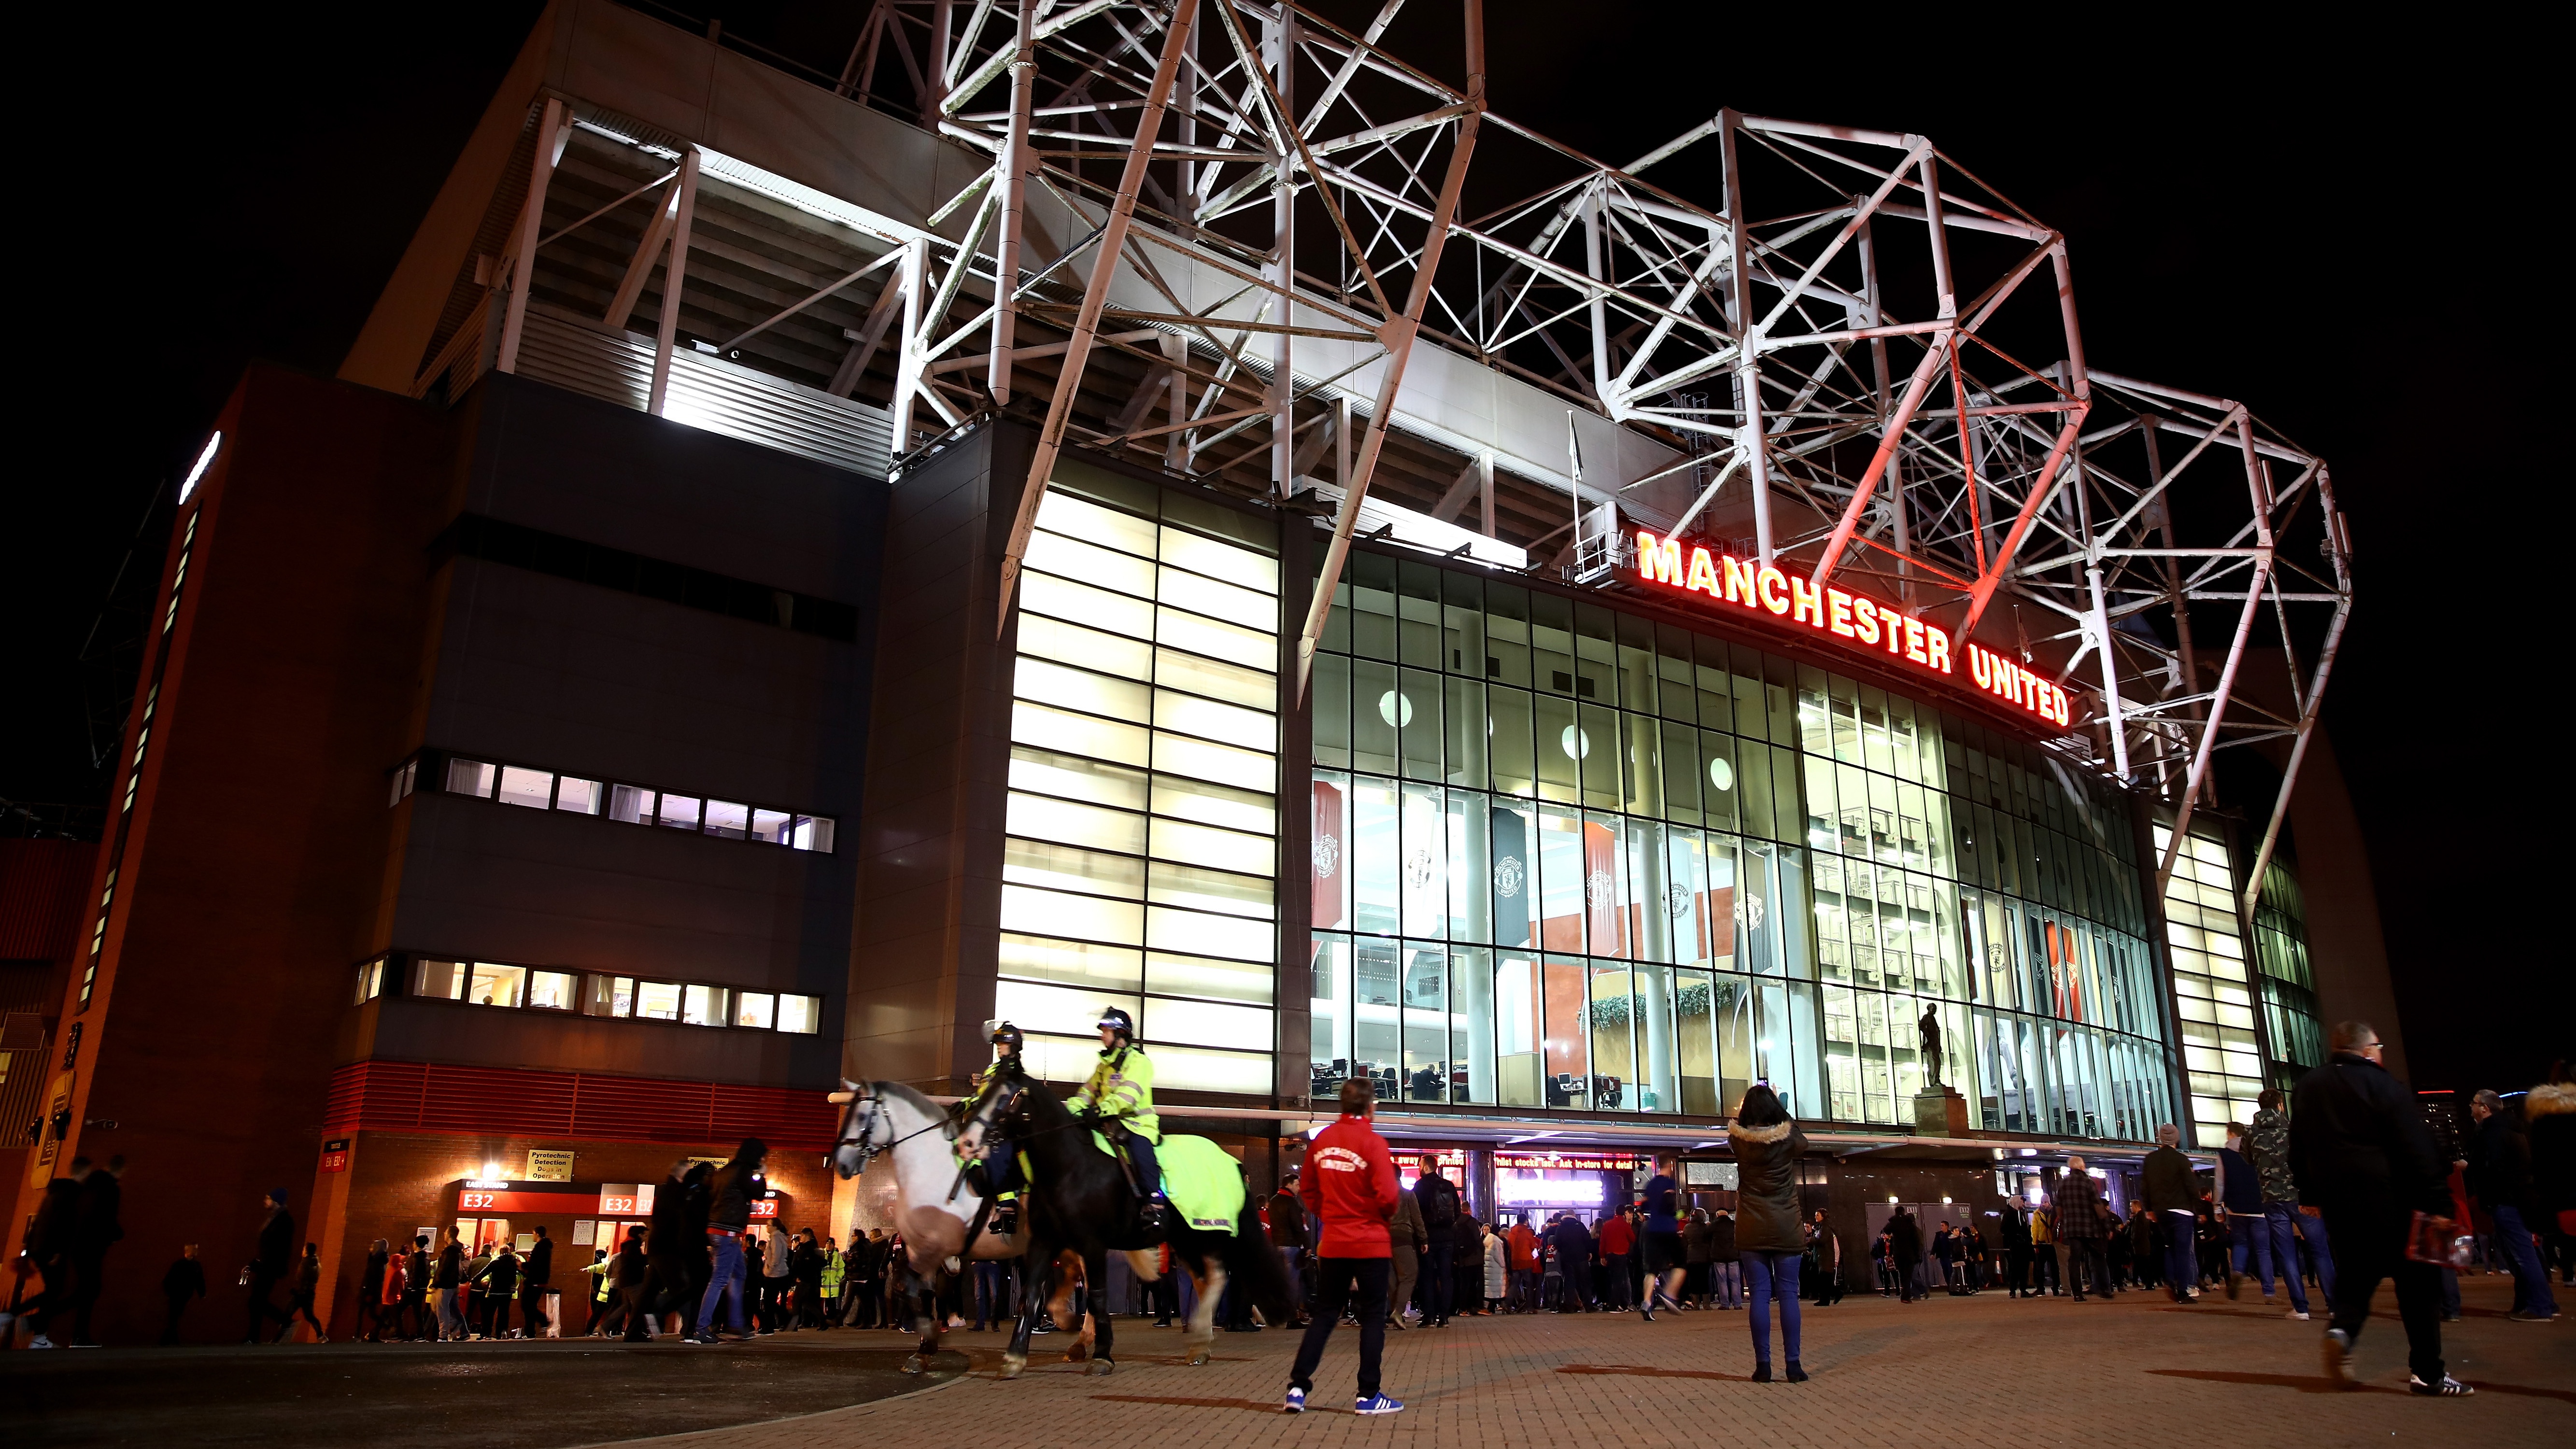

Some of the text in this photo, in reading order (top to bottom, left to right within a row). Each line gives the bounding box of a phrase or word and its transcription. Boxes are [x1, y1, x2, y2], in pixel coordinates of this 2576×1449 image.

[1637, 531, 2069, 727] MANCHESTER UNITED
[1500, 886, 1517, 894] UNITED
[1398, 1156, 1419, 1166] away
[1437, 1157, 1464, 1167] printed
[1515, 1158, 1539, 1167] stocks
[1559, 1159, 1572, 1168] Ask
[1575, 1160, 1601, 1168] in-store
[1603, 1160, 1613, 1168] for
[463, 1194, 494, 1208] E32
[605, 1198, 632, 1211] E32
[638, 1199, 652, 1212] E32
